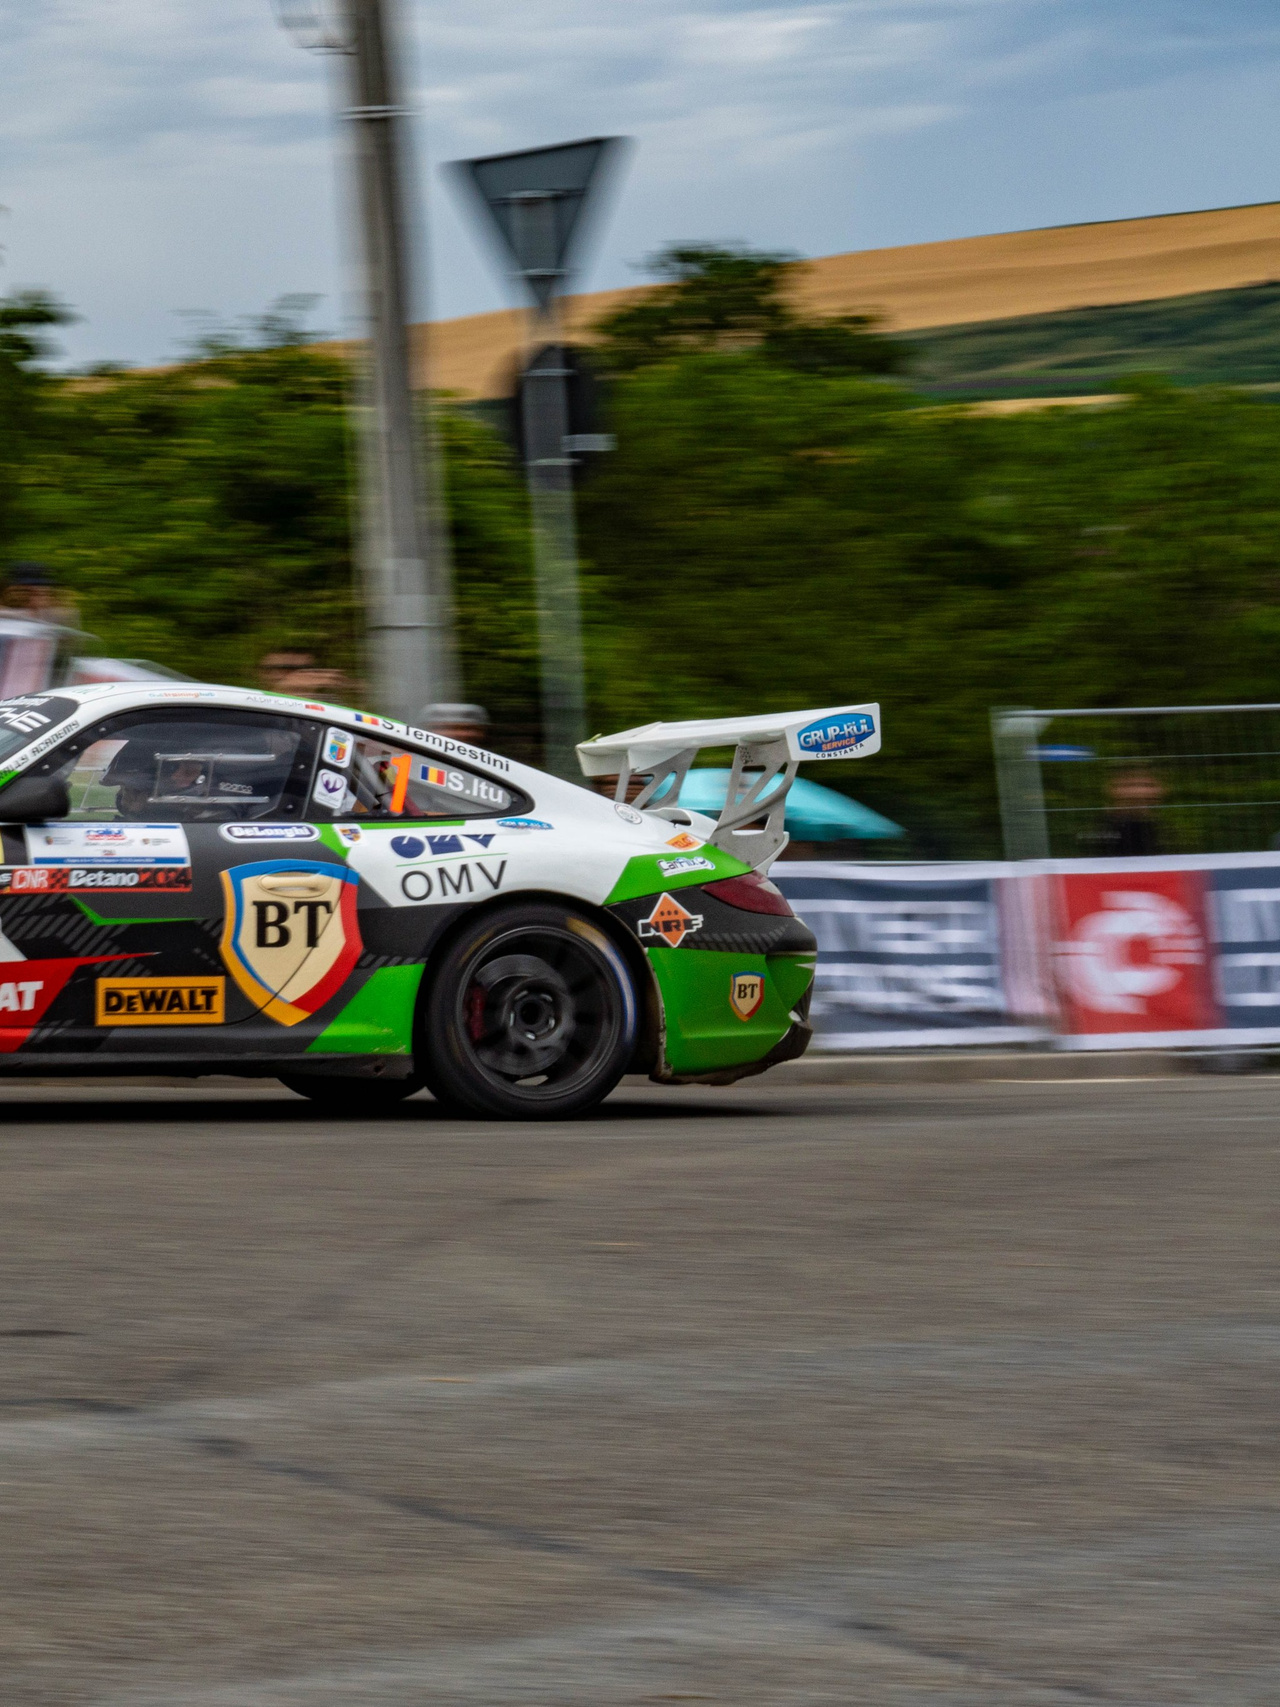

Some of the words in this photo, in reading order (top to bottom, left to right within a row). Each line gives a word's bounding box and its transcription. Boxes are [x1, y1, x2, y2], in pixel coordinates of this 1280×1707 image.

[31, 719, 81, 756] ACADEMY
[816, 743, 864, 758] CONSTANTA
[822, 737, 856, 751] SERVICE
[390, 754, 412, 813] 1
[448, 772, 504, 804] S.Itu
[13, 870, 49, 889] CNR
[68, 870, 140, 888] Betano
[401, 860, 507, 901] OMV
[253, 900, 333, 948] BT
[737, 983, 758, 999] BT
